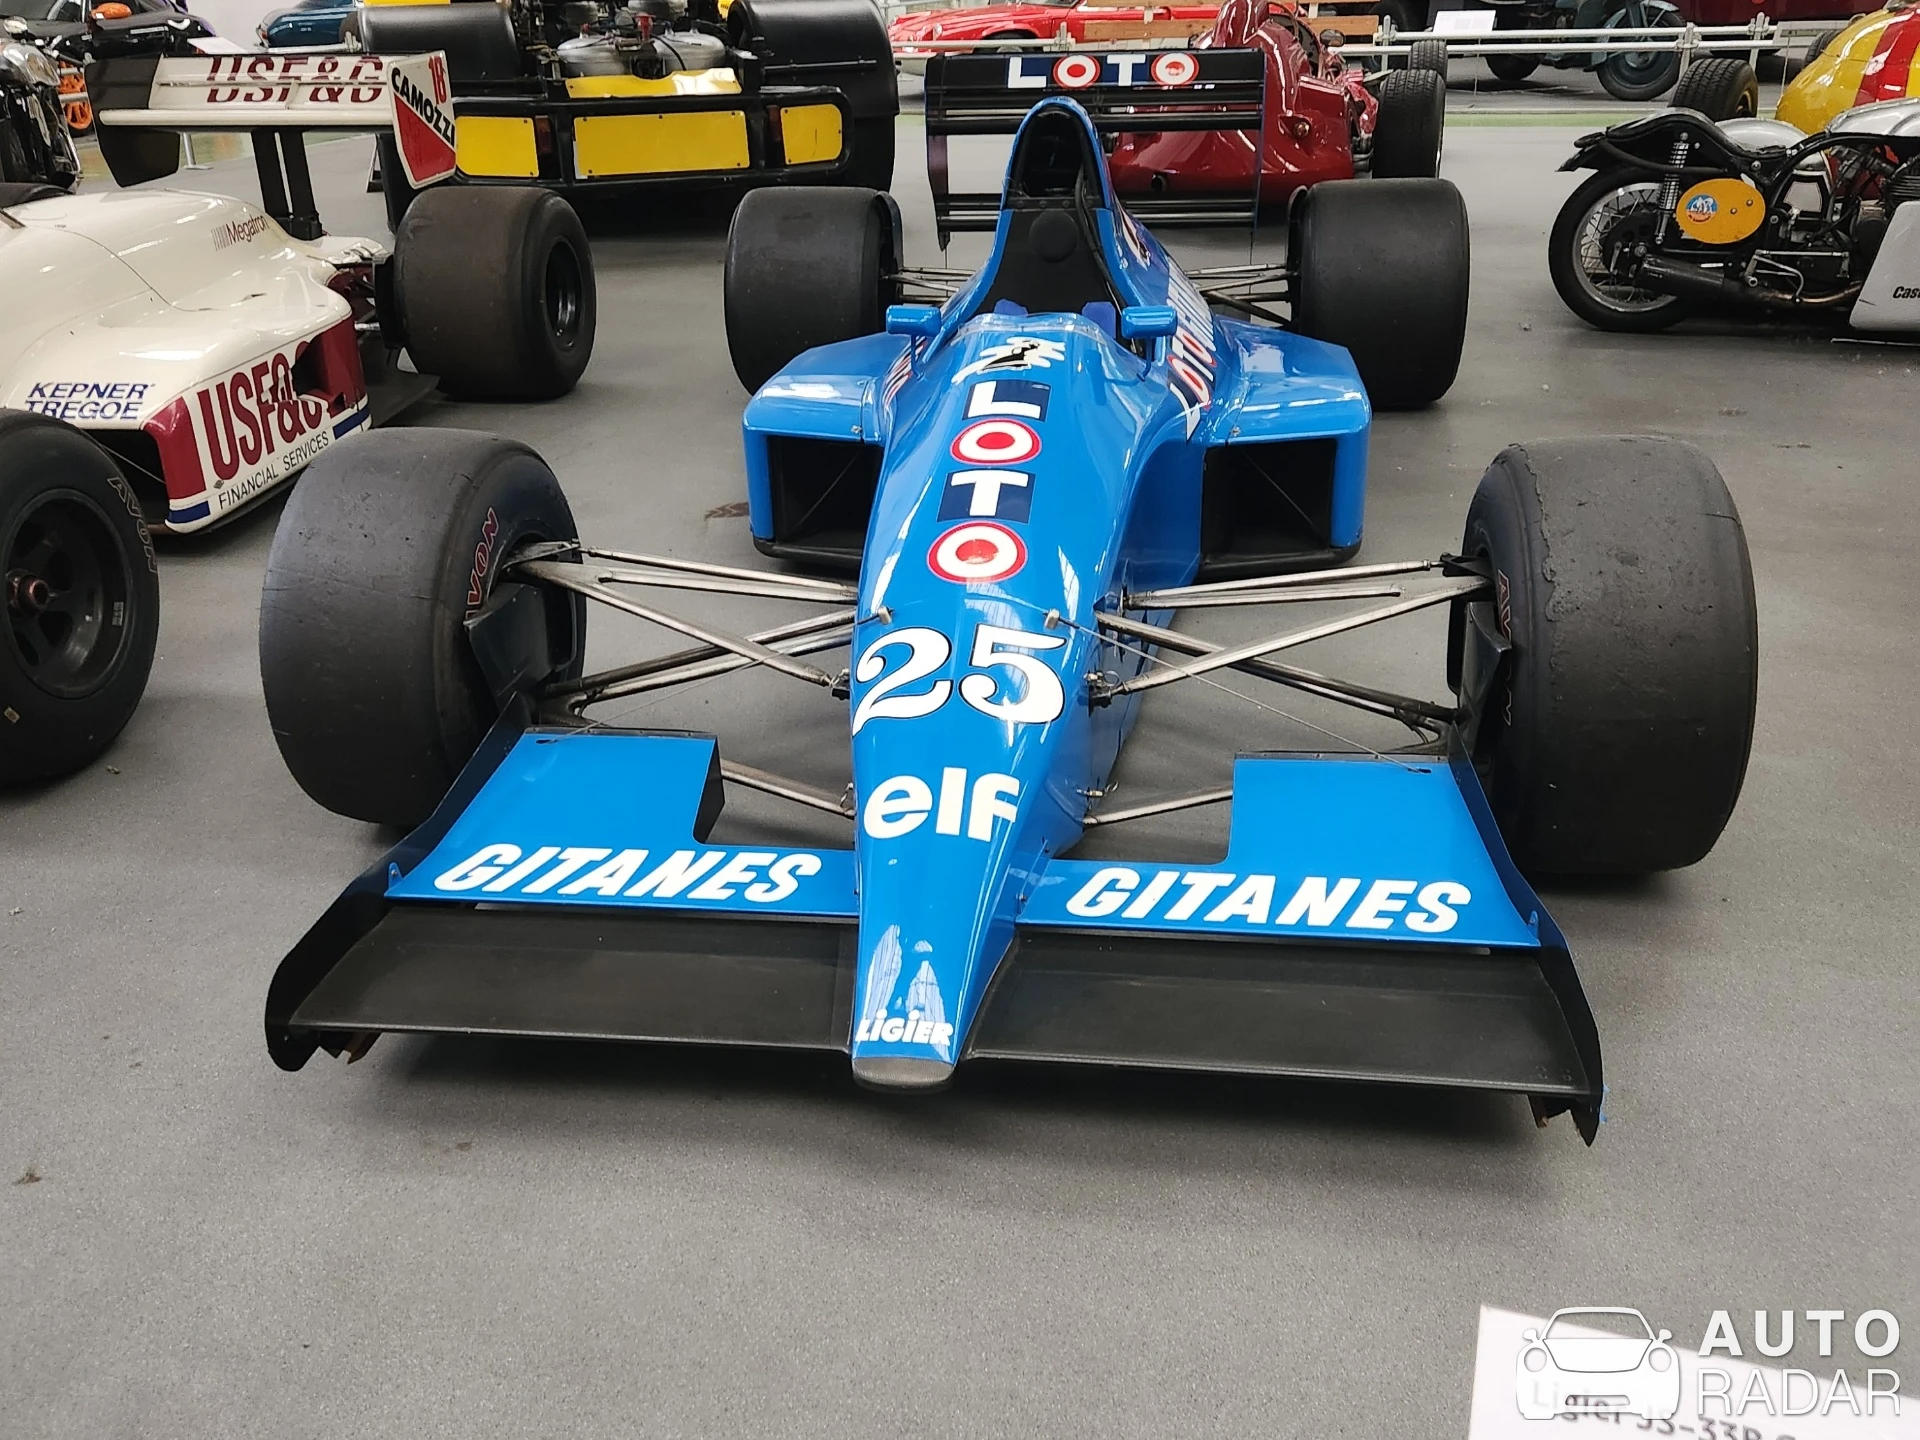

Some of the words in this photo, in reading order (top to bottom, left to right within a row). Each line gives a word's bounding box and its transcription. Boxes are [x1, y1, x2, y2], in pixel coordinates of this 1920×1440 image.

[207, 55, 383, 103] USF&G
[1007, 52, 1199, 90] LOTO
[392, 67, 455, 148] CAMOZZI
[226, 214, 270, 243] Megatron
[1893, 286, 1920, 299] Cas
[25, 400, 143, 419] TREGOE
[28, 382, 149, 399] KEPNER
[218, 463, 279, 510] FINANCIAL
[283, 431, 329, 471] SERVICES
[107, 476, 158, 574] AVON
[465, 506, 499, 620] VON
[852, 623, 1067, 738] 25
[863, 766, 1020, 842] elf
[434, 843, 822, 902] GITANES
[1066, 867, 1471, 933] GITANES
